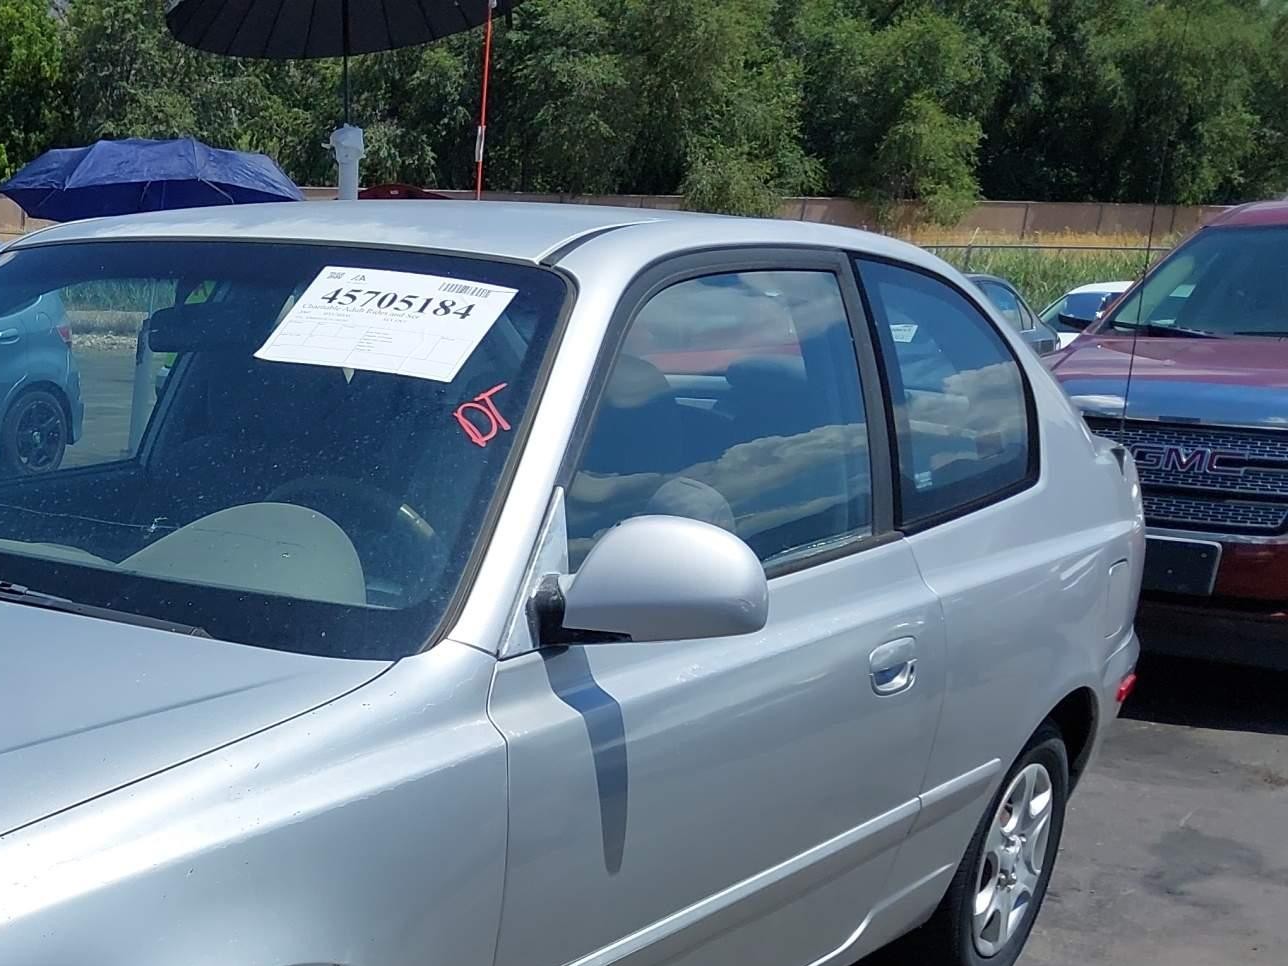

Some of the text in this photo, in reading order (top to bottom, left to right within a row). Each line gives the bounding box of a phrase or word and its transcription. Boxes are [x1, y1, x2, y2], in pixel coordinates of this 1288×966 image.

[320, 287, 476, 320] 45705184
[453, 383, 512, 447] DT
[1130, 443, 1249, 477] GMC
